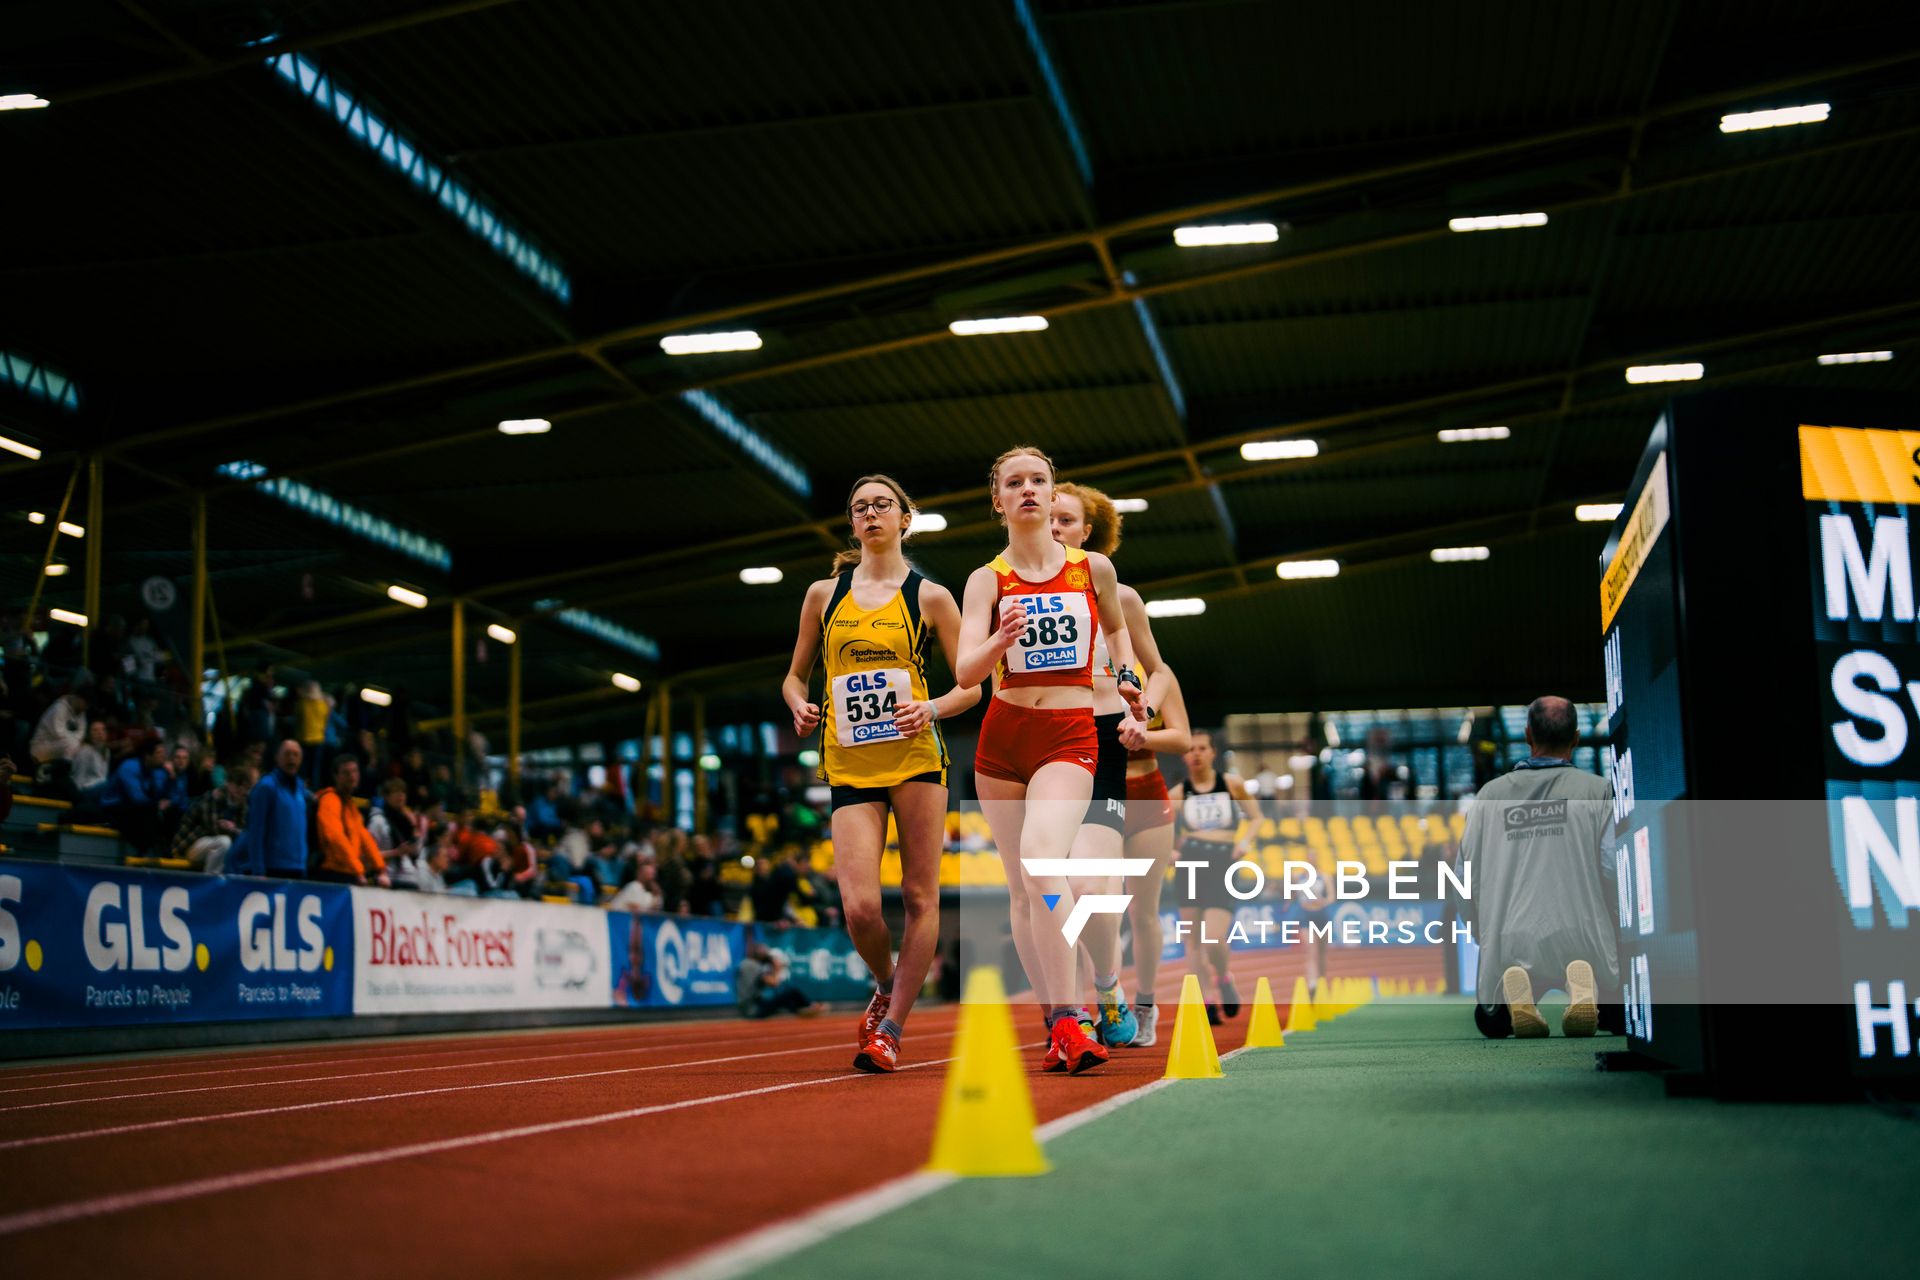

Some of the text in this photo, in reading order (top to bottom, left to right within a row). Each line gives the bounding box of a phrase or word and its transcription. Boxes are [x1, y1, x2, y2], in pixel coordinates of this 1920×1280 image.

[1820, 514, 1920, 621] M
[1019, 615, 1078, 648] 583
[1046, 649, 1075, 661] PLAN
[846, 690, 898, 722] 534
[871, 723, 898, 734] PLAN
[1530, 803, 1565, 818] PLAN
[1535, 827, 1565, 838] PARTNER
[368, 908, 440, 966] Black
[443, 915, 515, 967] Forest
[85, 982, 191, 1012] Parcels to People
[1854, 979, 1920, 1058] H
